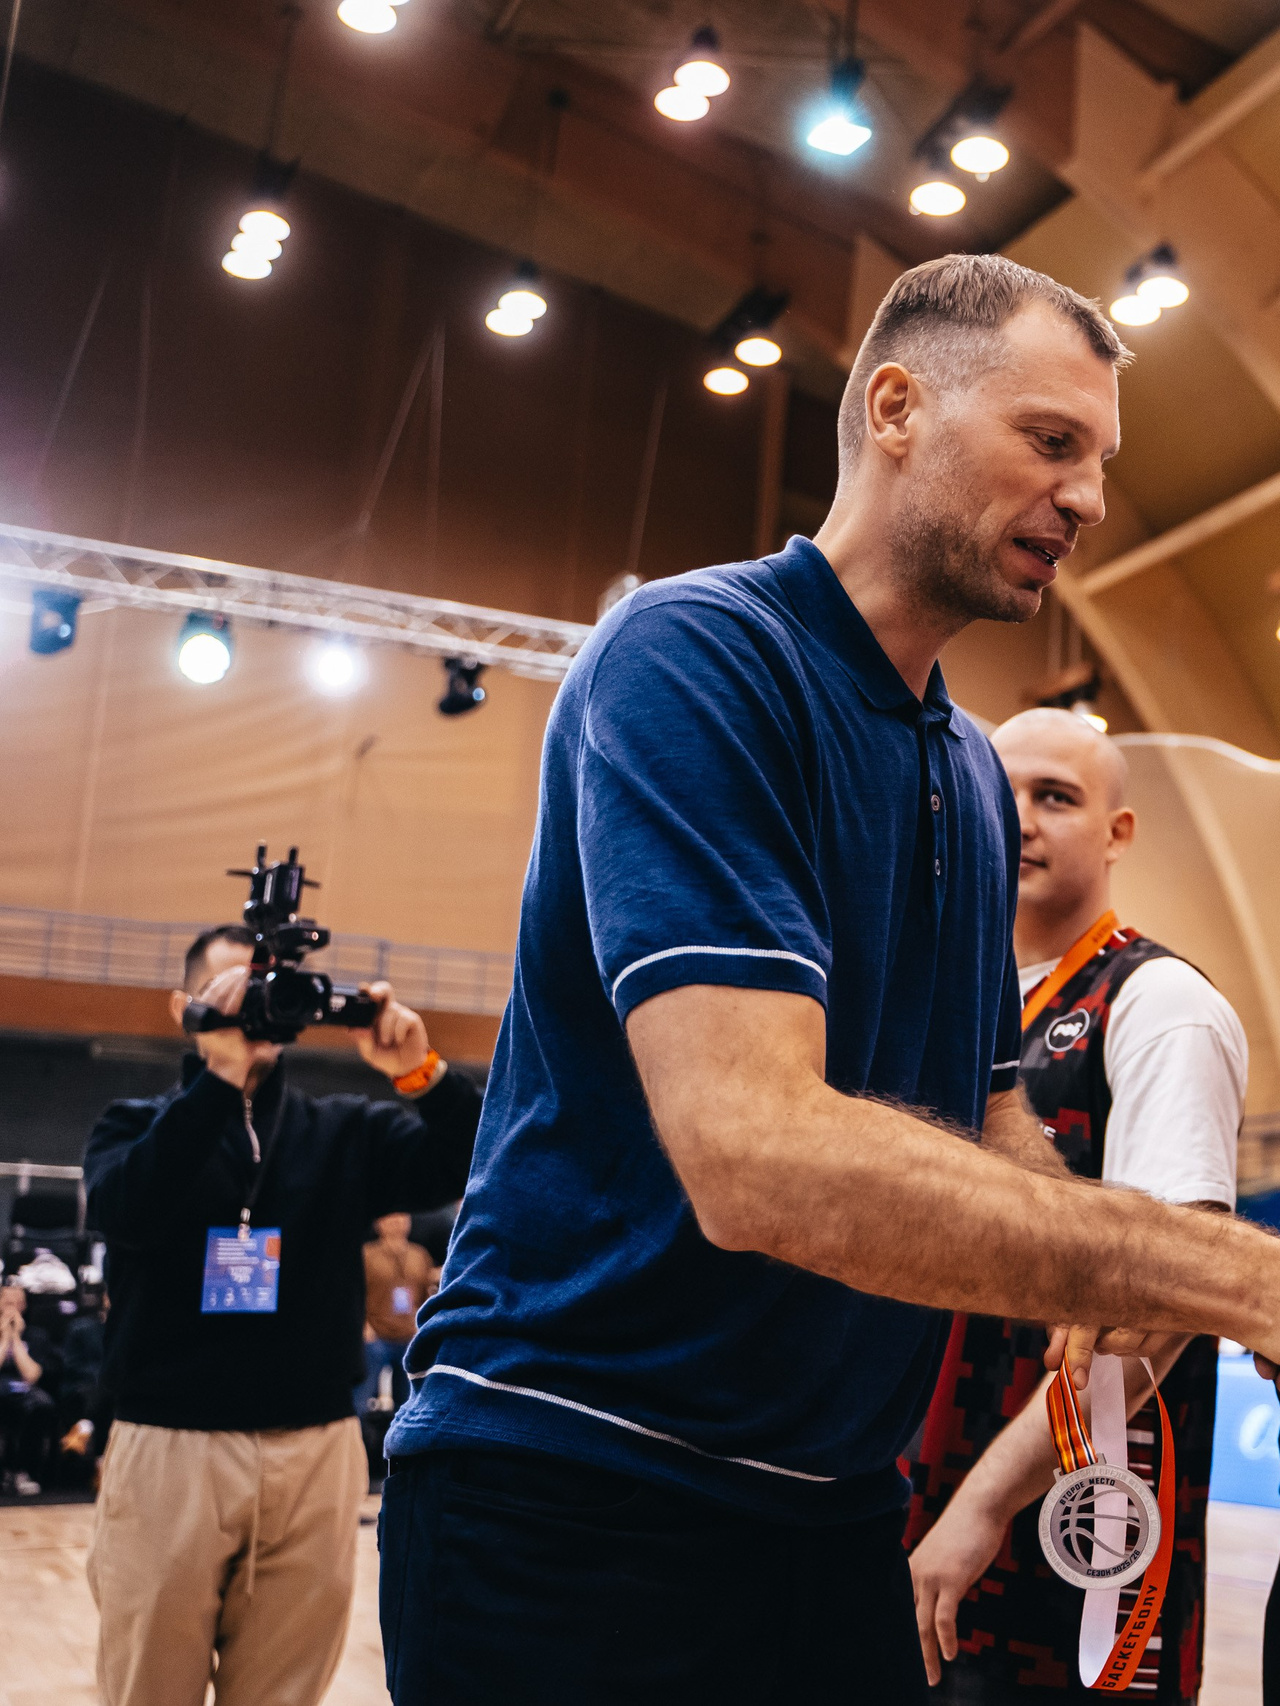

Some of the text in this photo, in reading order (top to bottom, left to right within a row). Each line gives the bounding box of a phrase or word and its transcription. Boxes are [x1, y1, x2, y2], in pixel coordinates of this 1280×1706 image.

[1060, 1477, 1116, 1505] ВТОРОЕ МЕСТО
[1086, 1549, 1141, 1577] СЕЗОН 2025/26
[1101, 1584, 1158, 1688] БАСКЕТБОЛУ
